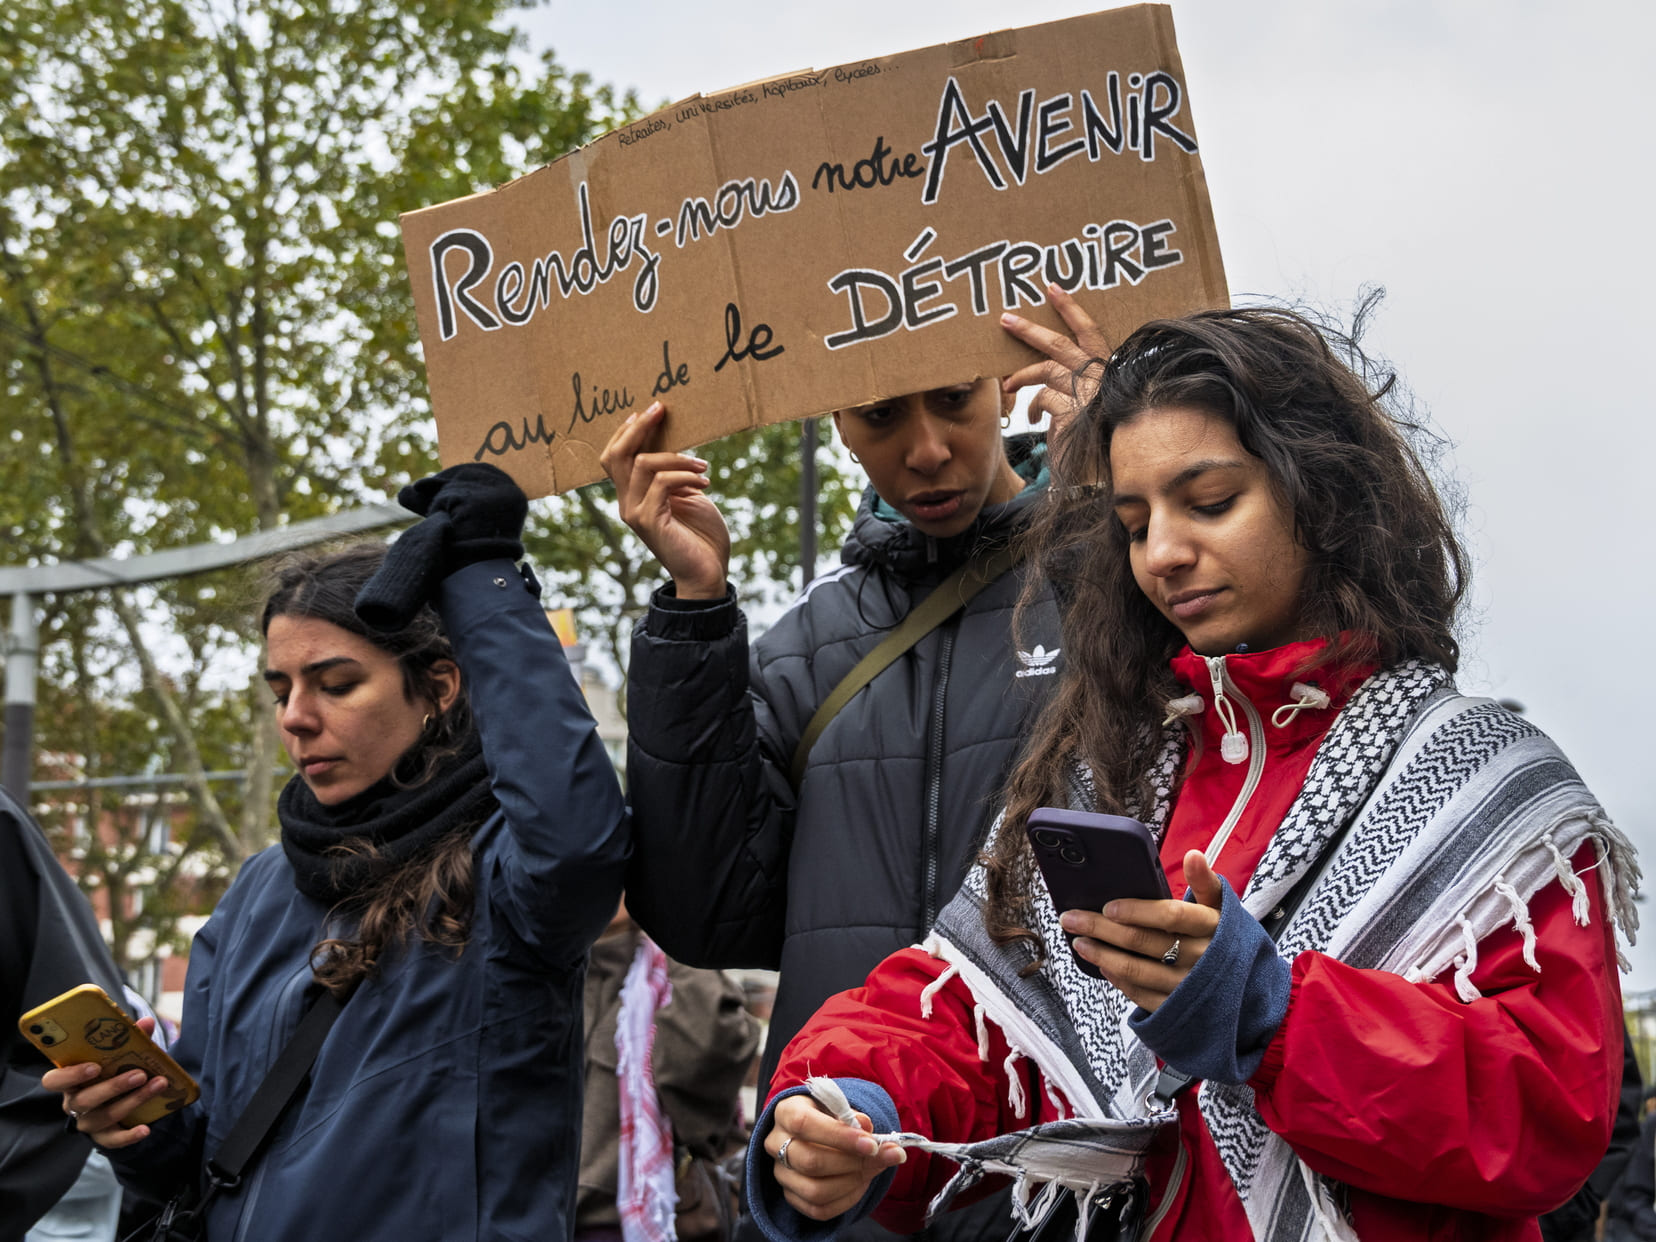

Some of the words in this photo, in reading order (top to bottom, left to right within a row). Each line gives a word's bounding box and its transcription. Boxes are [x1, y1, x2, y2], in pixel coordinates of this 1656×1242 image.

[429, 170, 800, 341] Rendez-nous
[812, 136, 925, 193] notre
[474, 414, 557, 461] au
[567, 371, 635, 434] lieu
[652, 340, 690, 397] de
[714, 302, 785, 372] le
[1016, 667, 1056, 678] adidas
